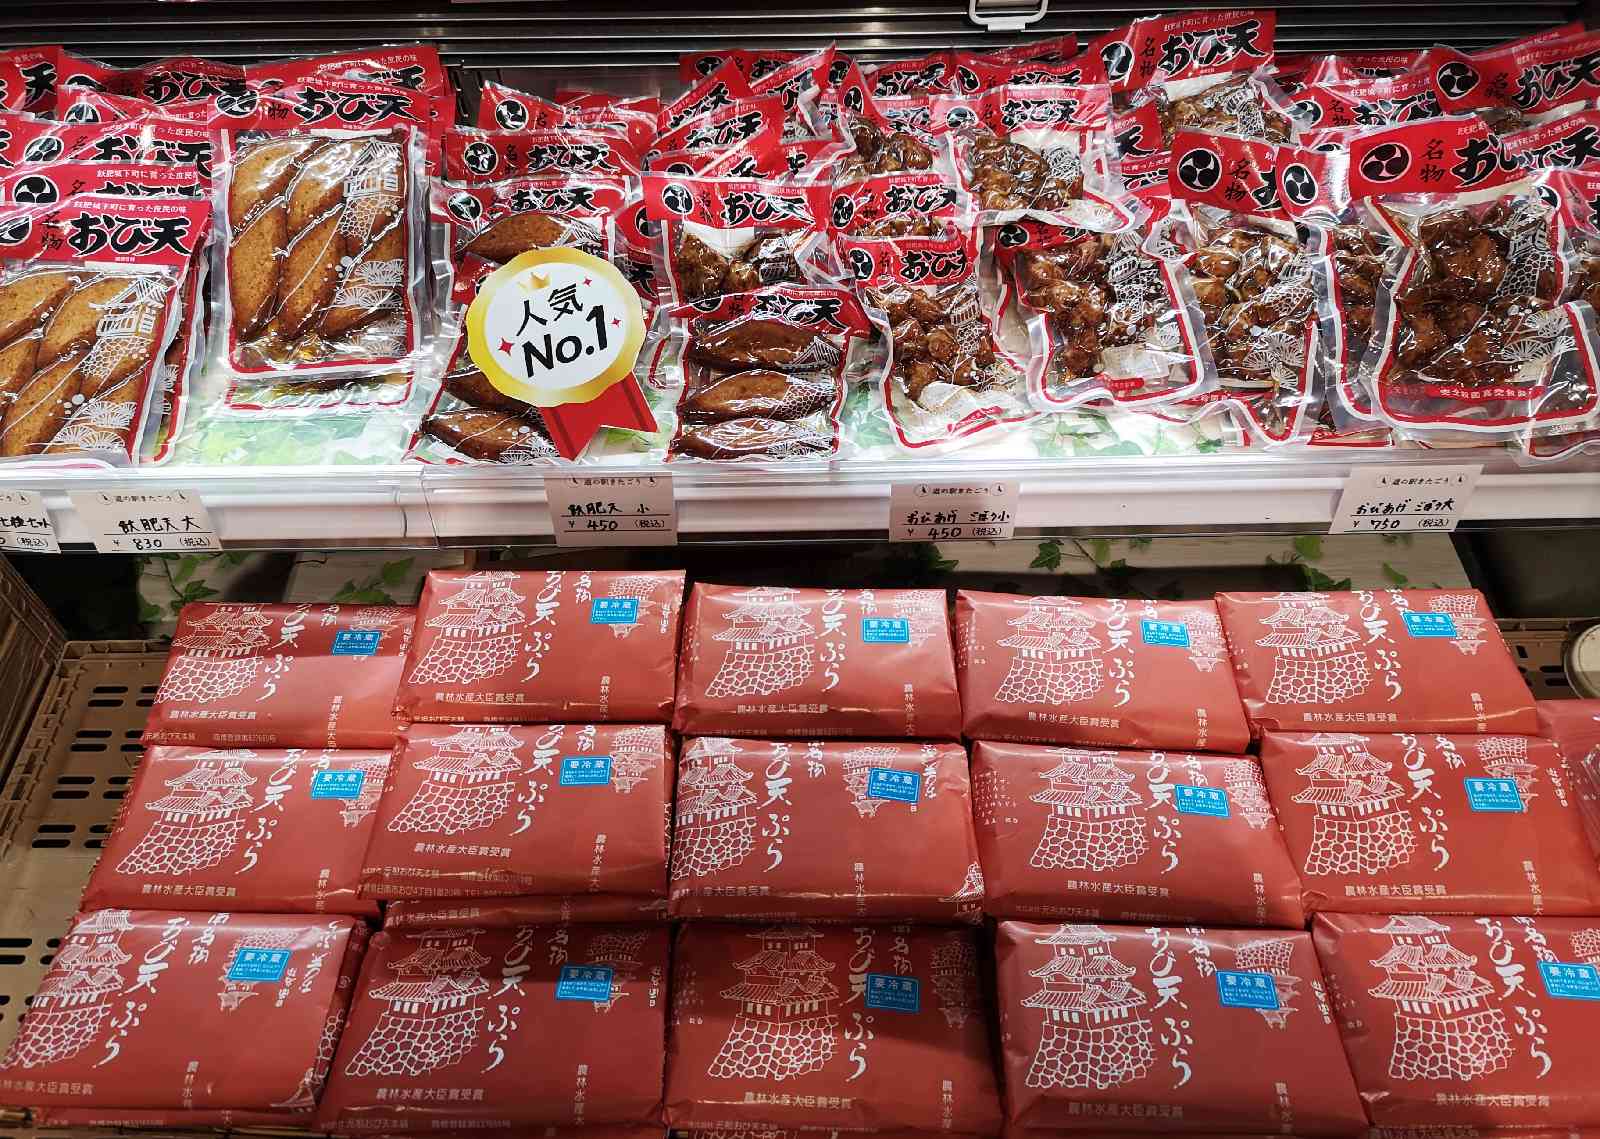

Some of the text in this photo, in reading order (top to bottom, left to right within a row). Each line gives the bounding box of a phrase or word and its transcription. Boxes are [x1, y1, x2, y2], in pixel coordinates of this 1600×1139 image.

[1158, 18, 1270, 78] おび天
[1140, 36, 1157, 78] 名物
[293, 85, 425, 126] おび天
[1328, 99, 1351, 126] 名物
[1419, 138, 1446, 183] 名物
[1224, 159, 1250, 201] 名物
[67, 211, 192, 257] おび天
[516, 283, 584, 337] 人気
[522, 304, 608, 378] No.1
[567, 502, 651, 517] 飫肥天 小
[1356, 498, 1412, 514] おびあげ
[118, 515, 202, 534] 飫肥天 大
[587, 519, 619, 531] 450
[633, 519, 665, 528] (税込)
[1370, 519, 1401, 530] 750
[1417, 518, 1450, 528] (税込)
[928, 527, 962, 540] 450
[971, 527, 1002, 537] (税込)
[132, 538, 162, 550] 830
[179, 536, 210, 547] (税込)
[1352, 590, 1401, 701] おび天ぷら
[1303, 711, 1397, 722] 農林水産大臣賞受賞
[322, 772, 357, 782] 要冷蔵
[878, 772, 912, 785] 要冷蔵
[1473, 781, 1513, 793] 要冷蔵
[756, 742, 792, 873] おび天ぷら
[1392, 733, 1452, 871] おび天ぷら
[414, 842, 512, 858] 農林水産大臣賞受賞
[142, 884, 236, 897] 農林水産大臣賞受賞
[1067, 880, 1169, 898] 農林水産大臣賞受賞
[1345, 884, 1447, 897] 農林水産大臣賞受賞
[243, 951, 282, 963] 要冷蔵
[1549, 966, 1591, 979] 要冷蔵
[874, 977, 914, 993] 要冷蔵
[1226, 975, 1267, 989] 要冷蔵
[92, 916, 190, 1068] おび天ぷら
[480, 926, 541, 1075] おび天ぷら
[1475, 917, 1553, 1079] おび天ぷら
[838, 927, 876, 1083] おび天ぷら
[1145, 926, 1193, 1089] おび天ぷら
[0, 1080, 94, 1096] 林水産大臣賞受賞
[376, 1088, 485, 1102] 農林水産大臣賞受賞
